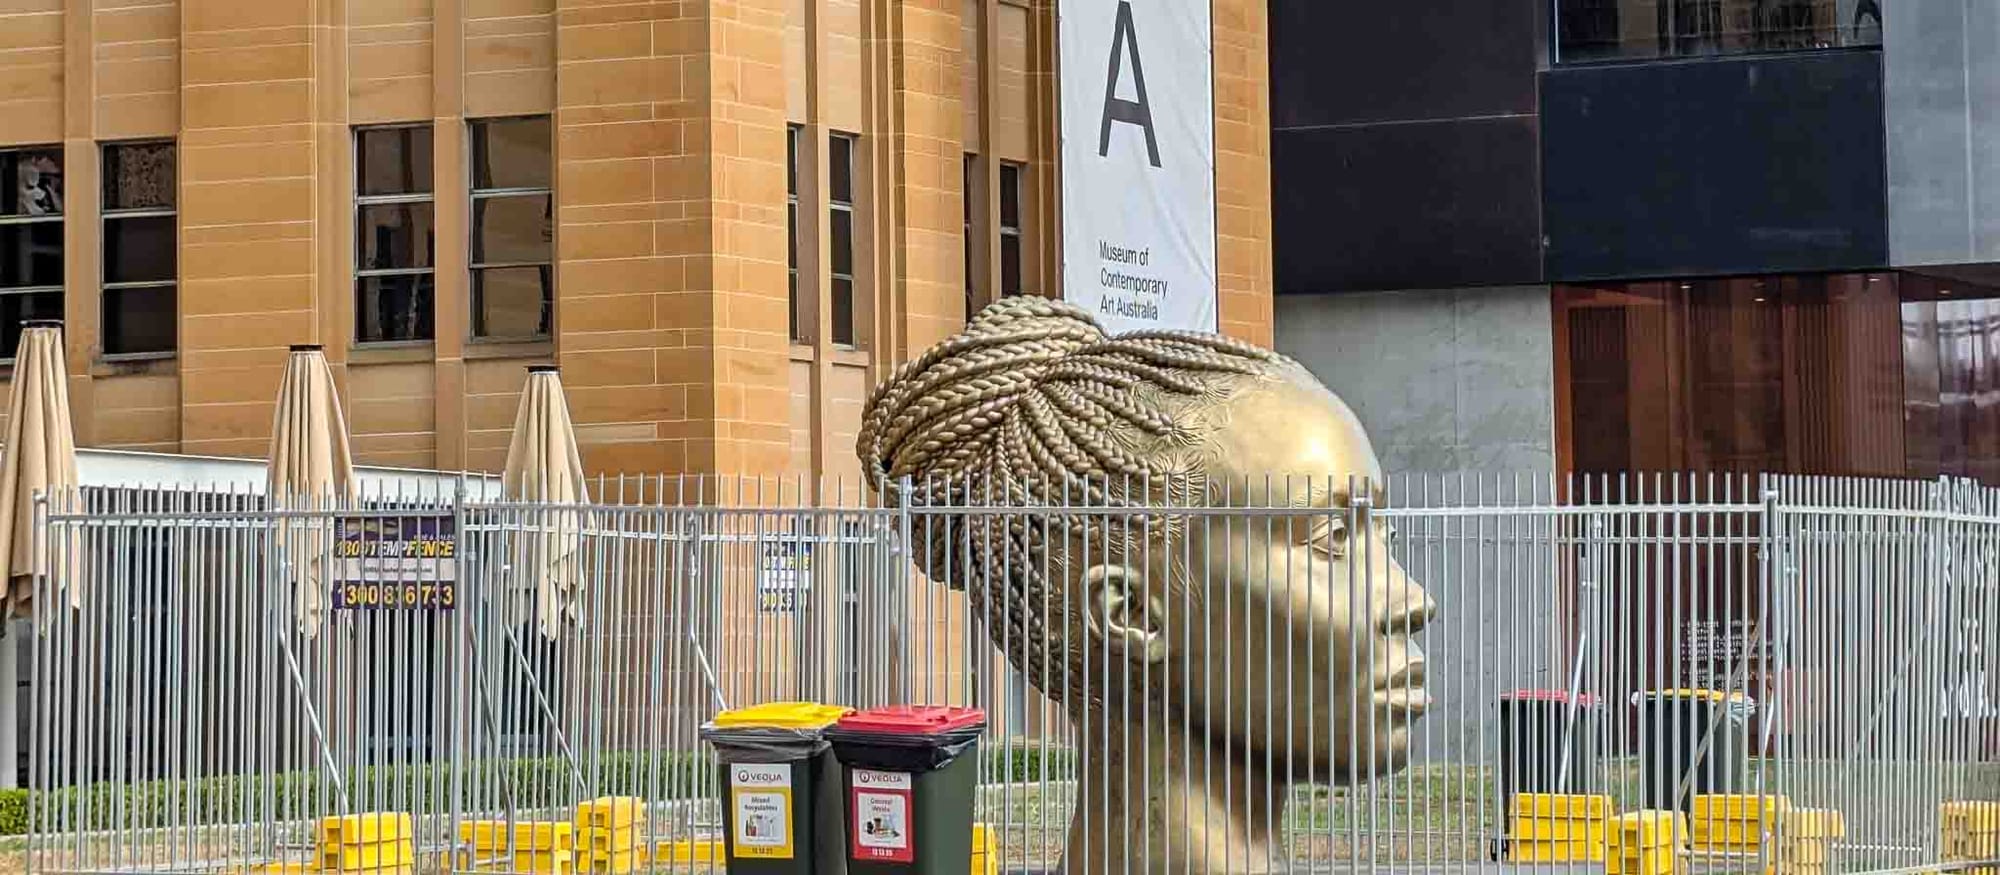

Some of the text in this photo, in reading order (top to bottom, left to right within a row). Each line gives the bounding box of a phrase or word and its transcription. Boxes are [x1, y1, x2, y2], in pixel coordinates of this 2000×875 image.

[1099, 0, 1161, 168] A
[1099, 240, 1149, 266] Museum of
[1101, 267, 1168, 299] Contemporary
[1100, 294, 1158, 320] Art Australia
[750, 773, 782, 782] VEOLIA
[872, 774, 902, 783] VEOLIA
